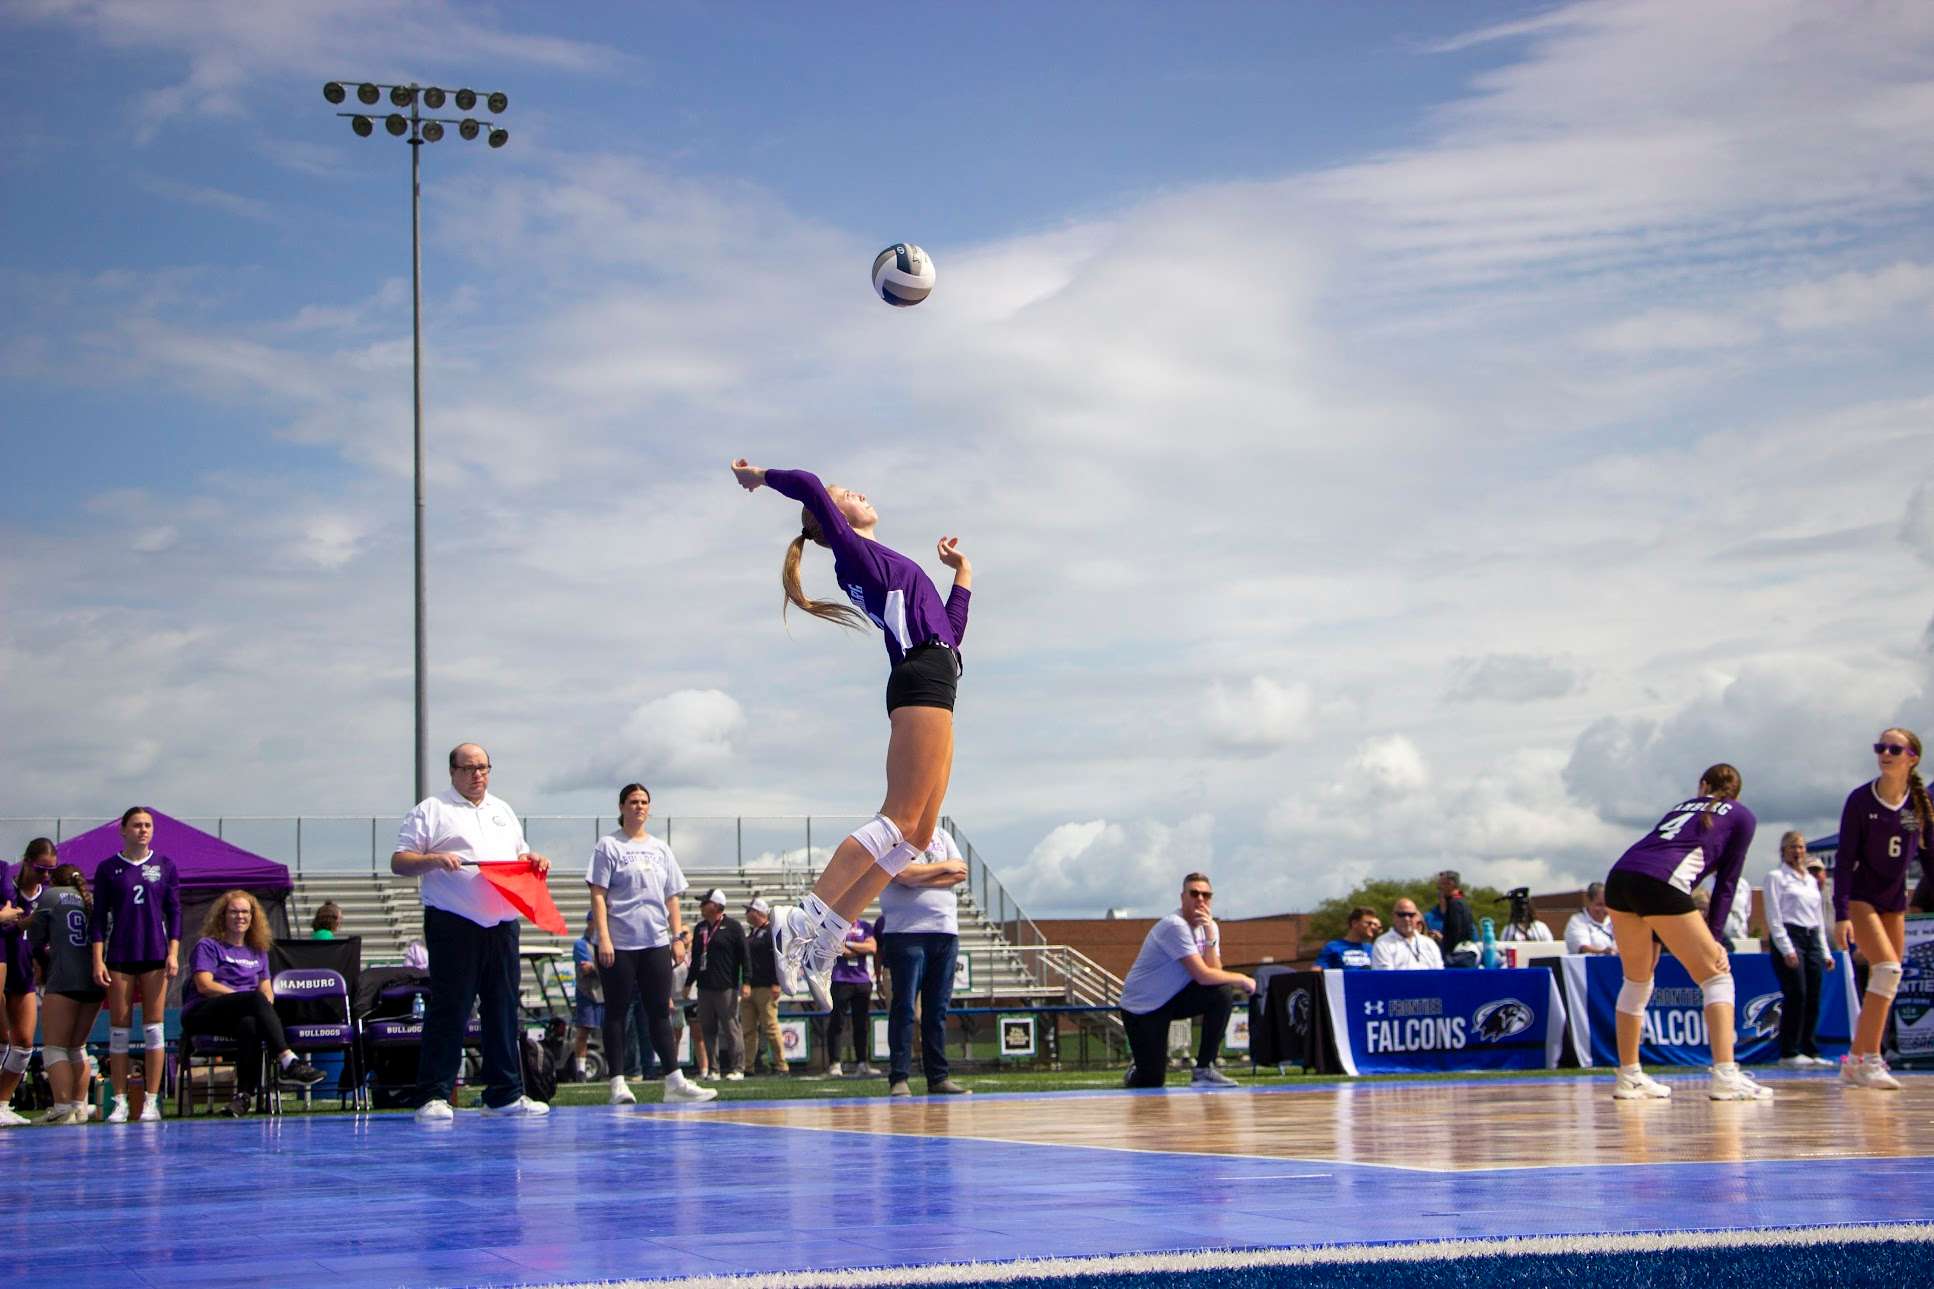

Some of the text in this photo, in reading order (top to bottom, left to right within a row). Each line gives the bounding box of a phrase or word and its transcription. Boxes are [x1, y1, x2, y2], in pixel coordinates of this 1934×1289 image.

[1659, 811, 1695, 840] 4
[1889, 836, 1902, 858] 6
[132, 884, 145, 905] 2
[66, 909, 88, 946] 9
[280, 978, 335, 989] HAMBURG
[299, 1029, 340, 1037] BULLDOGS
[386, 1026, 422, 1034] BULLDOG
[1366, 1016, 1467, 1053] FALCONS
[1640, 1008, 1738, 1047] ALCO
